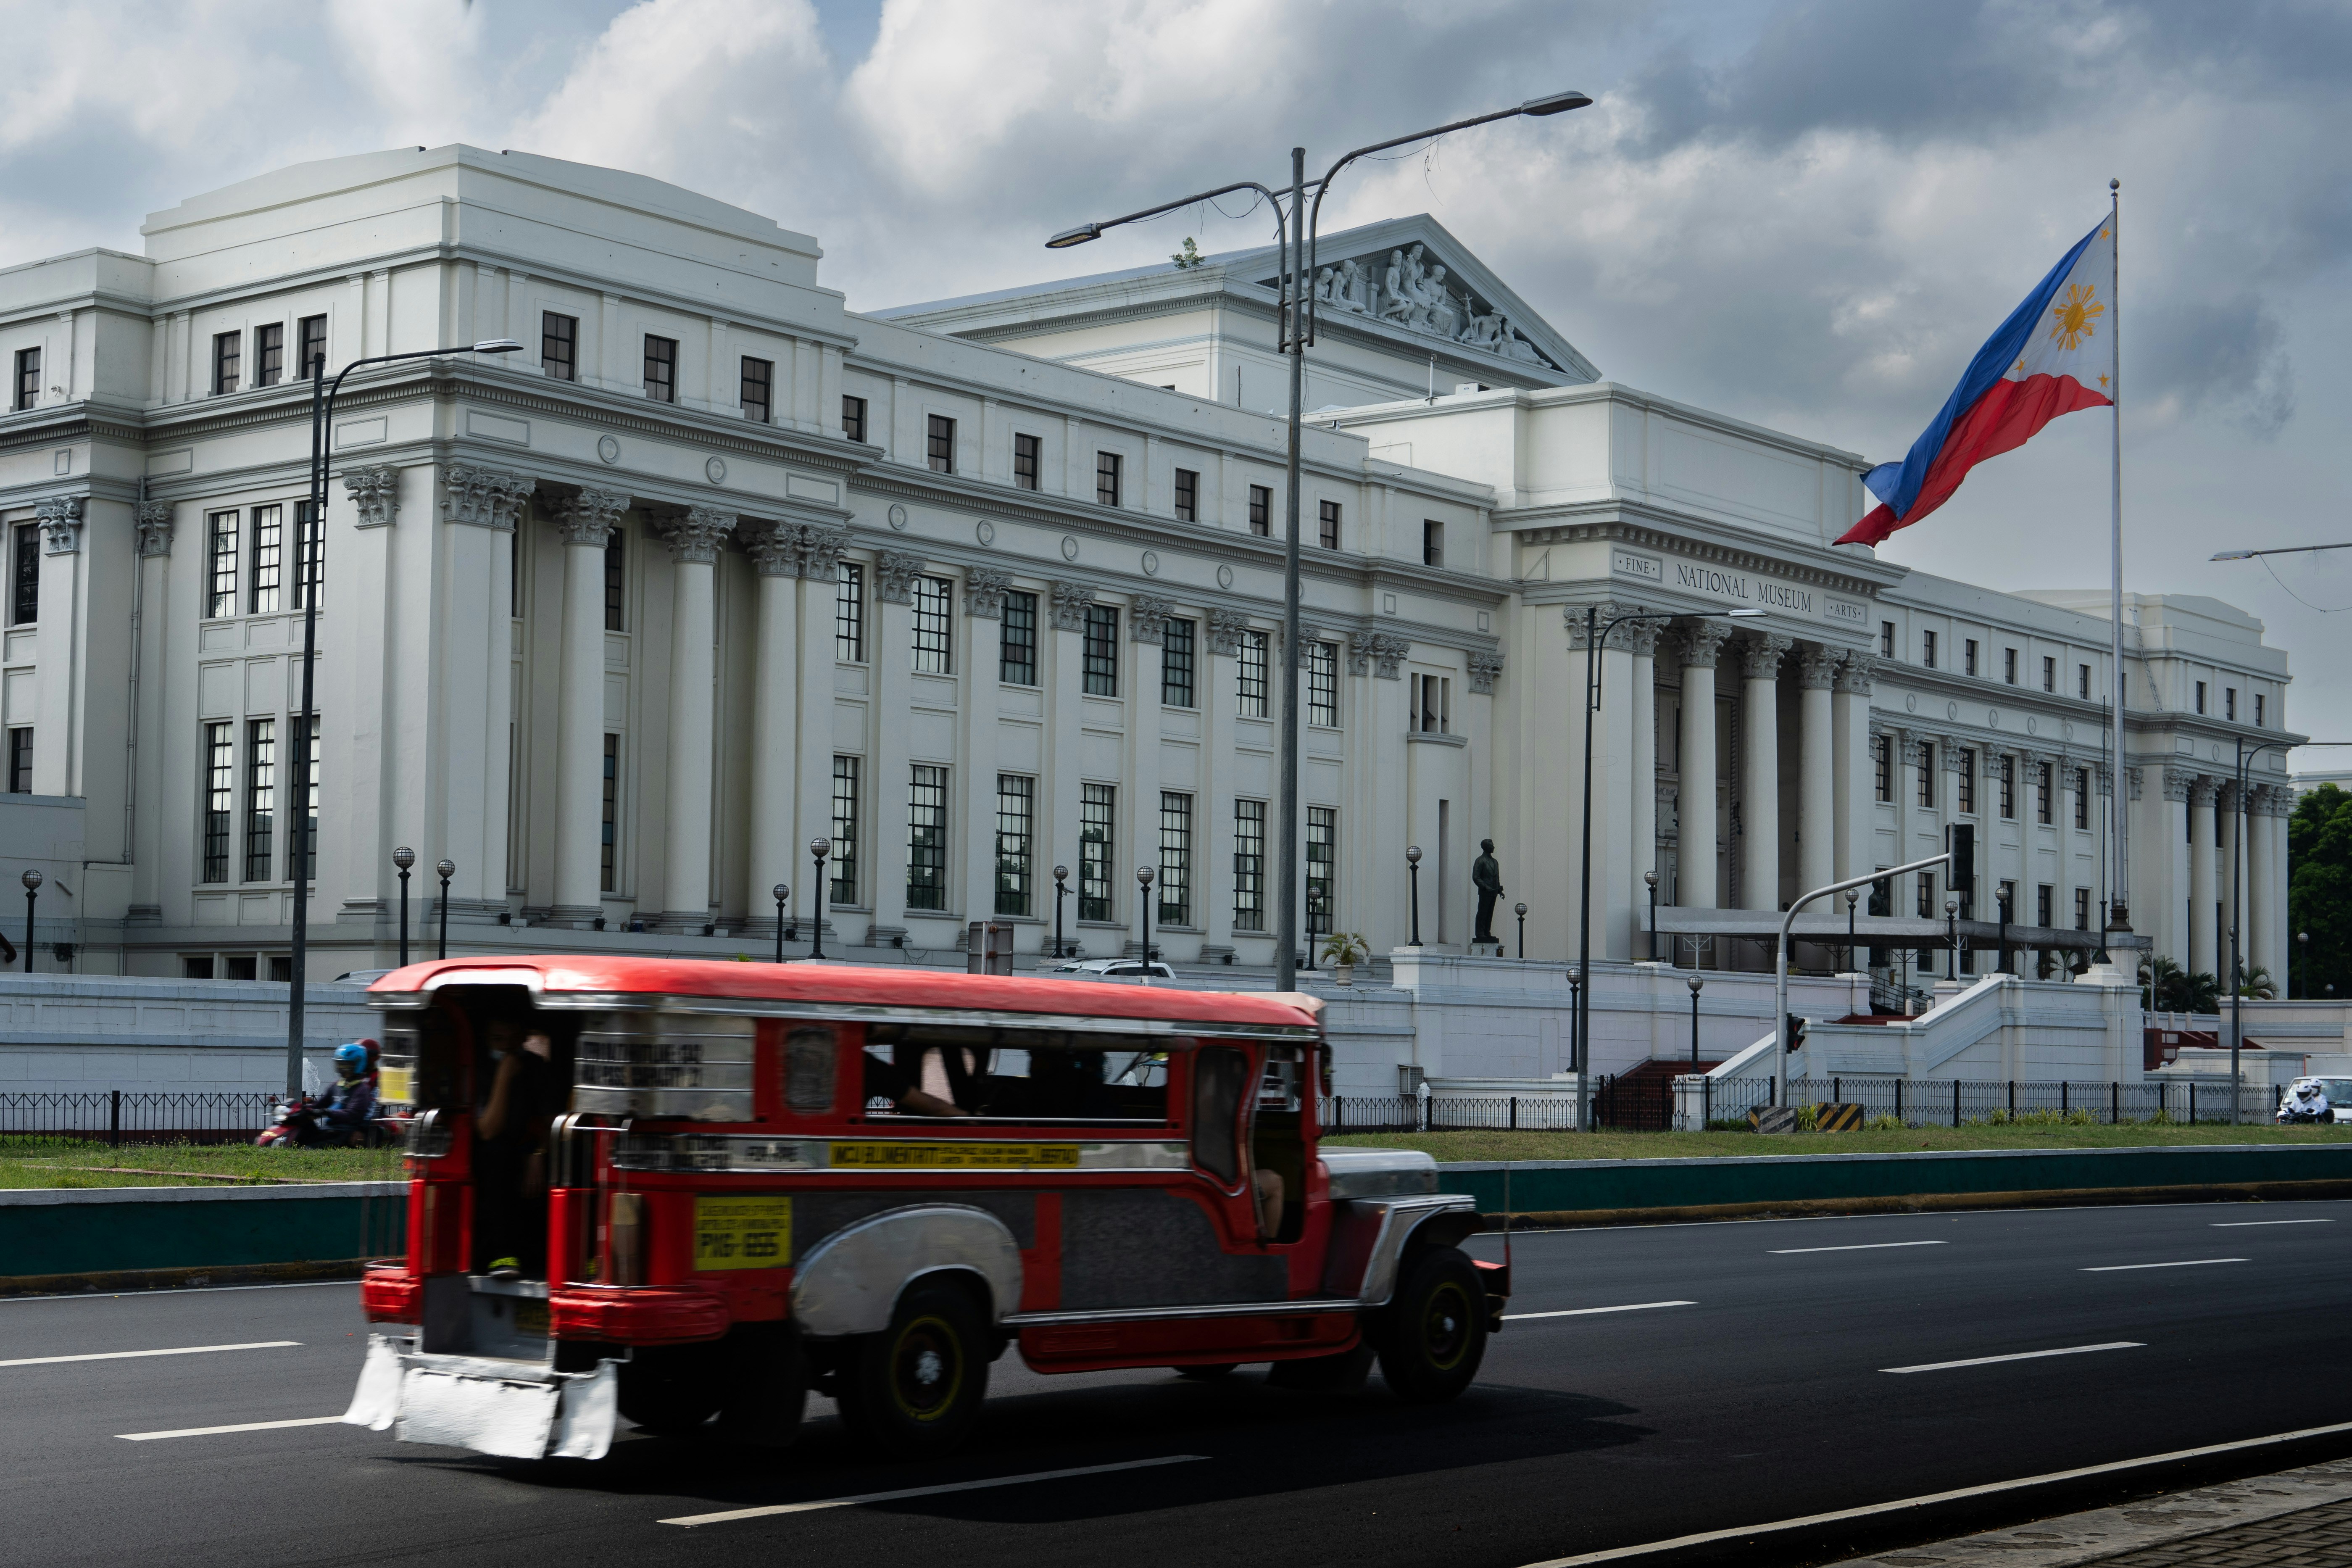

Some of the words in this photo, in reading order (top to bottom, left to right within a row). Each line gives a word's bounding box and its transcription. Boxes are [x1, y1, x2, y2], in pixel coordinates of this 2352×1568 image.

[1626, 558, 1649, 574] FINE
[1677, 564, 1749, 599] NATIONAL
[1757, 582, 1812, 612] MUSEUM
[1835, 604, 1857, 618] ARTS
